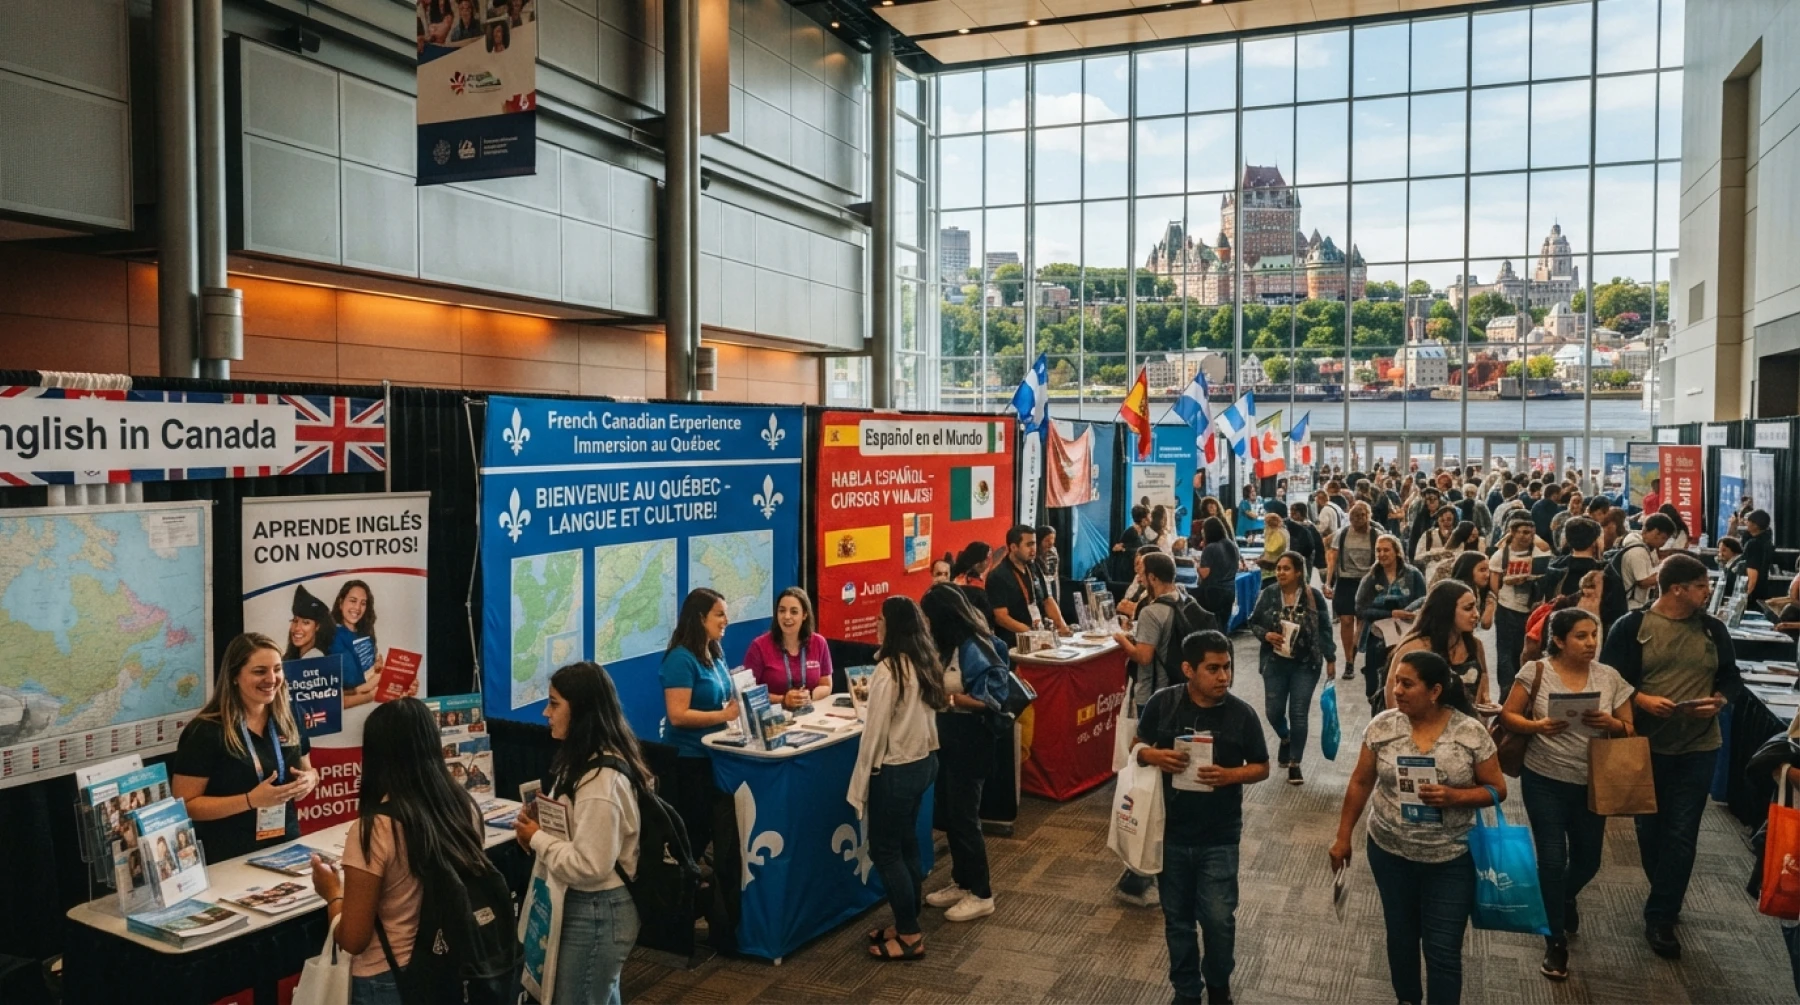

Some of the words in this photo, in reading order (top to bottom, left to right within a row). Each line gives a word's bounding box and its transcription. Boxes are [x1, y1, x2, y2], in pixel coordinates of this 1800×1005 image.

[120, 418, 149, 450] in
[161, 418, 276, 450] Canada
[548, 411, 598, 429] French
[602, 411, 666, 430] Canadian
[669, 414, 741, 433] Experience
[574, 436, 647, 454] Immersion
[651, 439, 667, 452] au
[671, 435, 721, 453] Québec
[866, 428, 913, 450] Español
[916, 432, 930, 446] en
[933, 428, 943, 446] el
[946, 428, 983, 446] Mundo
[831, 470, 872, 488] HABLA
[536, 482, 630, 509] BIENVENUE
[633, 480, 655, 501] AU
[659, 475, 721, 501] QUÉBEC
[883, 489, 890, 505] Y
[252, 517, 351, 540] APRENDE
[356, 510, 422, 533] INGLÉS
[548, 509, 617, 535] LANGUE
[620, 507, 641, 528] ET
[644, 501, 718, 525] CULTURE!
[254, 544, 300, 564] CON
[306, 536, 418, 561] NOSOTROS!
